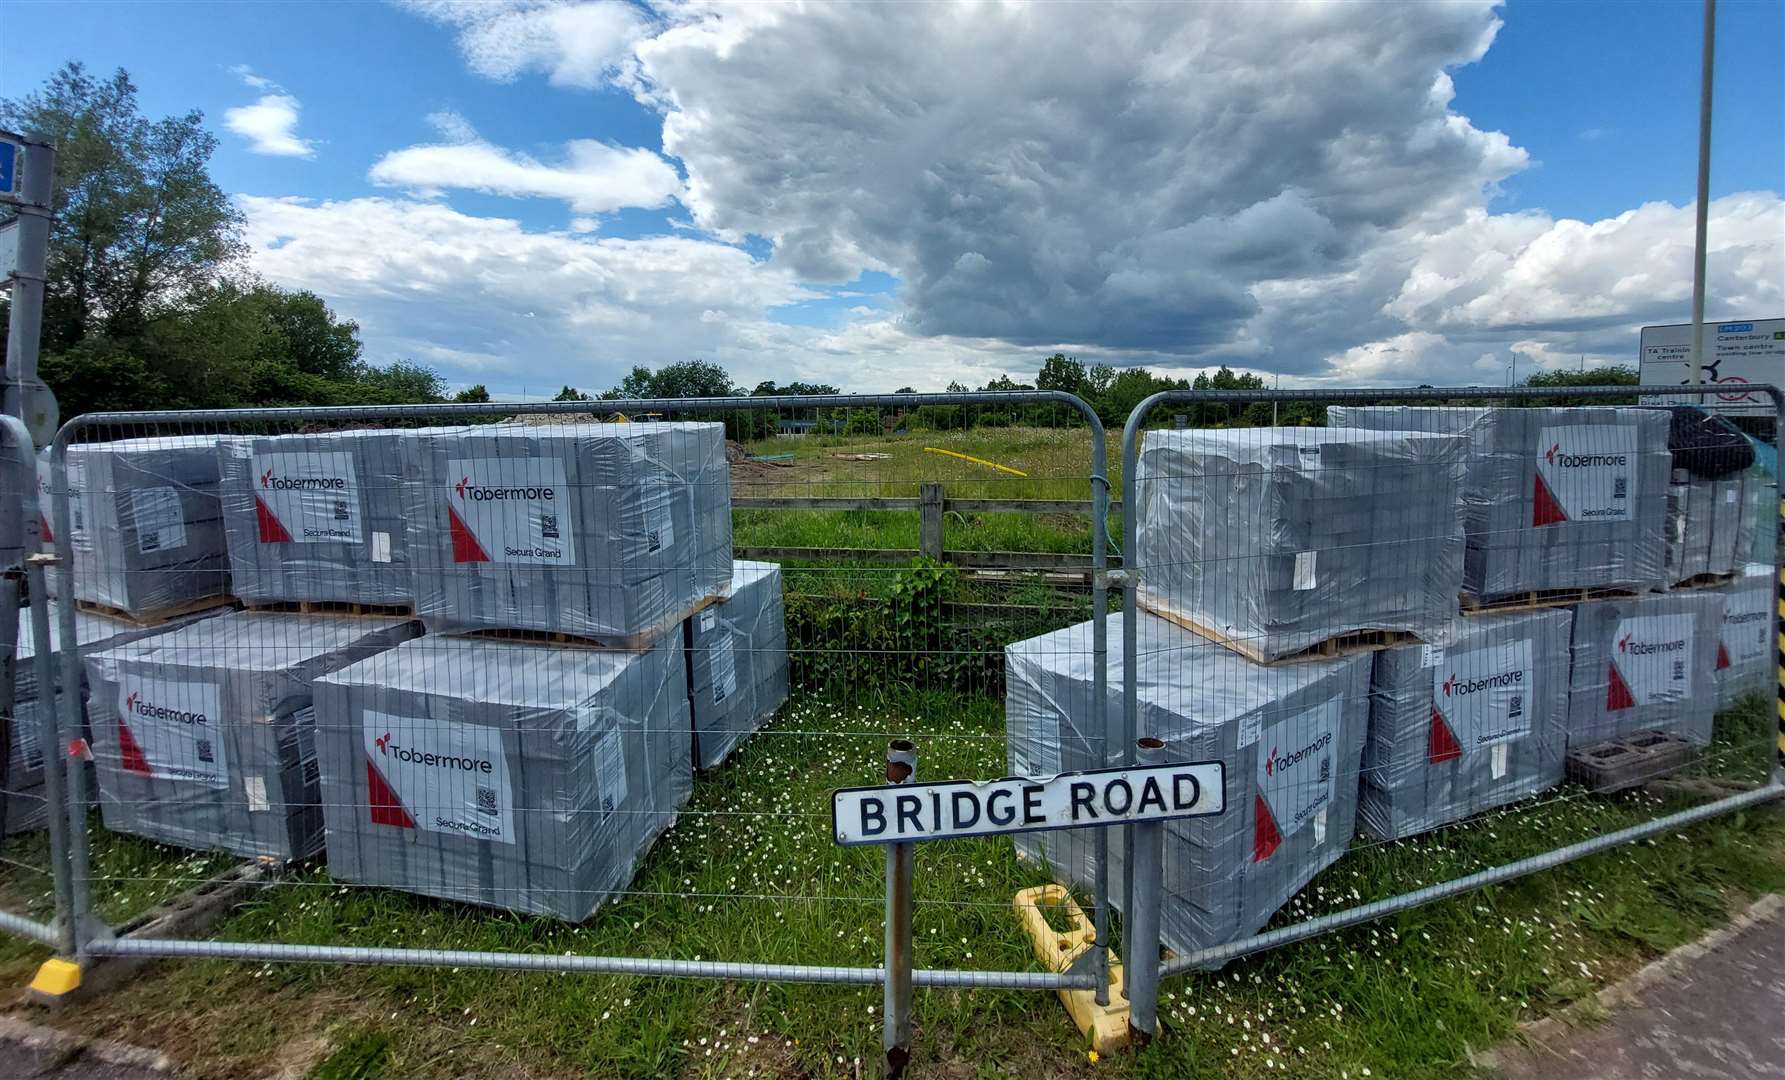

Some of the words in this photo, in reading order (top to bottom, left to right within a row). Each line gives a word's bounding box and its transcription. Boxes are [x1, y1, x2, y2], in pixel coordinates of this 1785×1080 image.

[1557, 453, 1626, 468] Tobermore
[269, 476, 344, 489] Tobermore
[465, 486, 554, 501] Tobermore
[505, 546, 534, 557] Secura
[534, 547, 561, 559] Grand
[1628, 639, 1685, 656] Tobermore
[1452, 670, 1522, 696] Tobermore
[134, 700, 207, 726] Tobermore
[389, 746, 493, 774] Tobermore
[1274, 733, 1332, 774] Tobermore
[859, 785, 1047, 837] BRIDGE
[1070, 773, 1201, 821] ROAD
[436, 816, 470, 831] Secura
[470, 821, 501, 836] Grand
